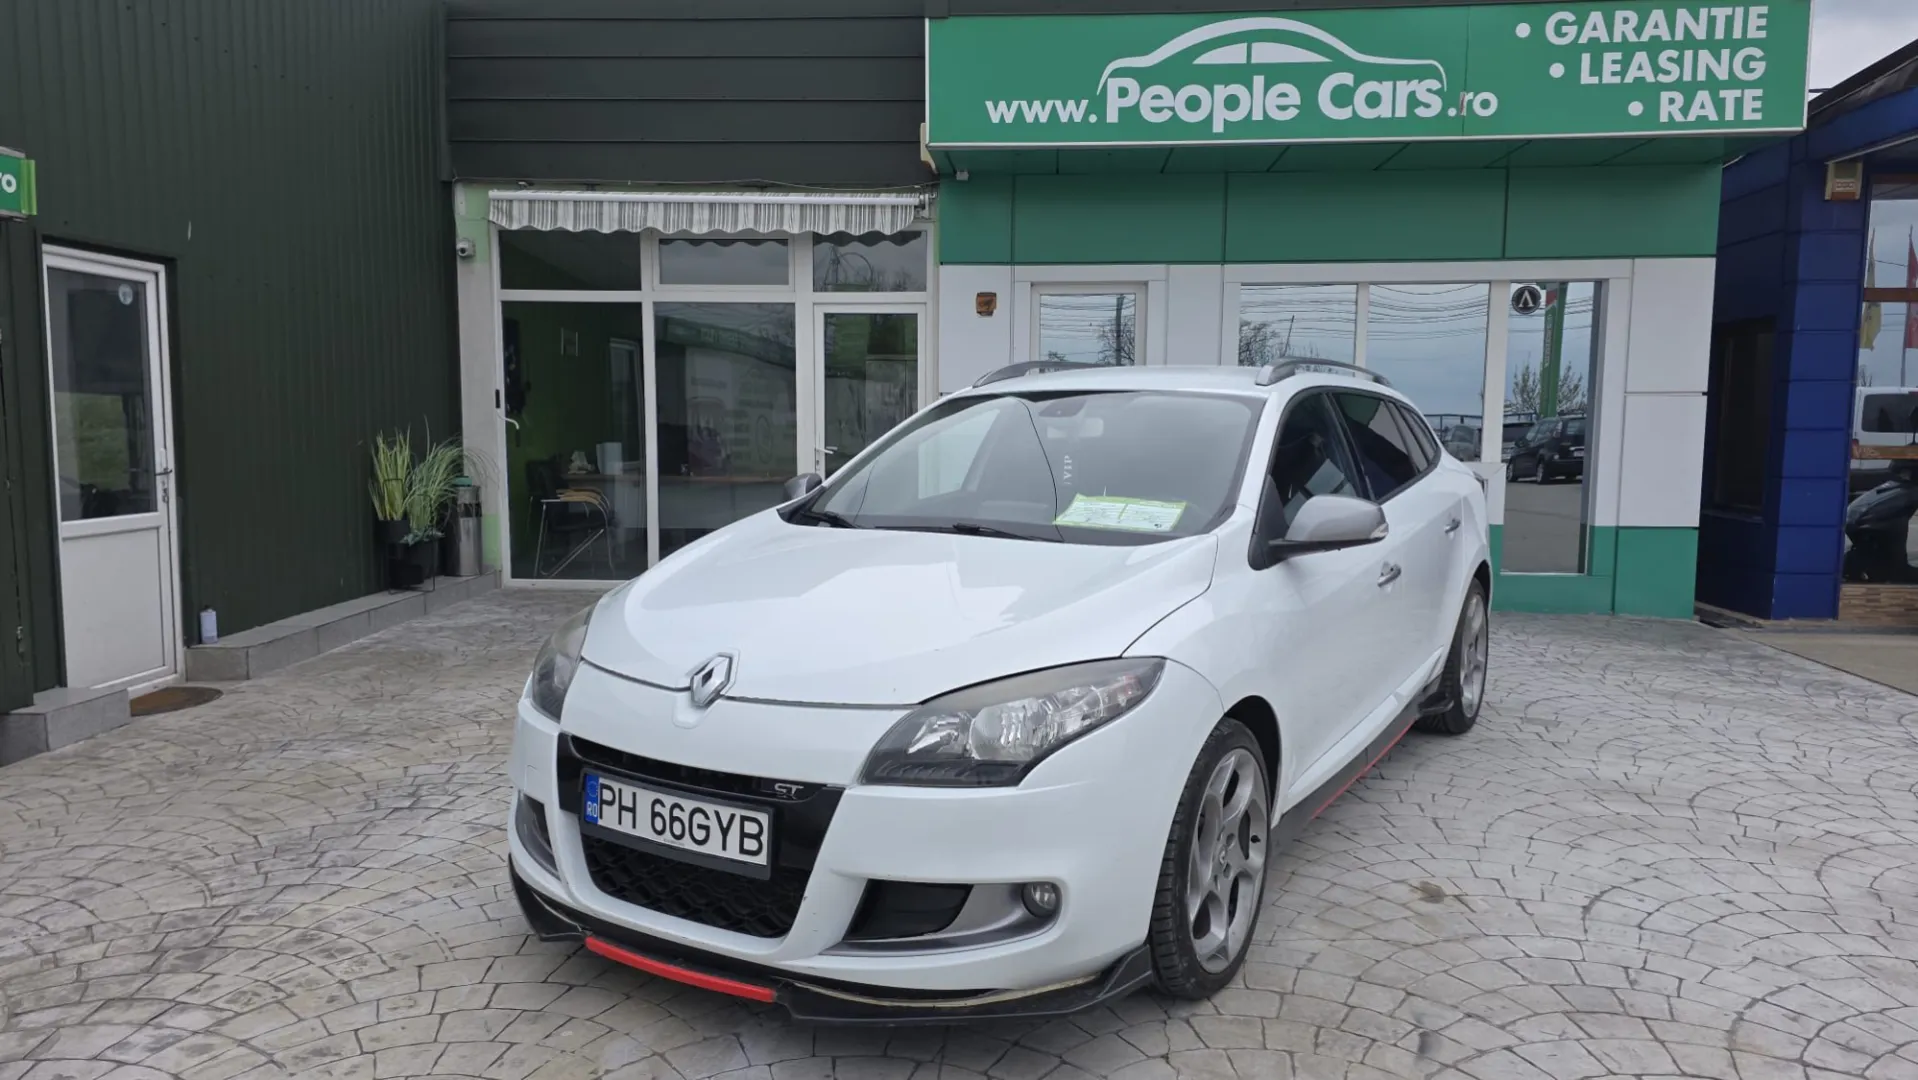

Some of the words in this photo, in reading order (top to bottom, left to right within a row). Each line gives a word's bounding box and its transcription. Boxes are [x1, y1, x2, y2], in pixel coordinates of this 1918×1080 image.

[1545, 6, 1769, 46] GARANTIE
[1580, 47, 1767, 84] LEASING
[1659, 89, 1764, 122] RATE
[586, 801, 598, 818] RO
[598, 782, 637, 830] PH
[650, 798, 764, 857] 66GYB
